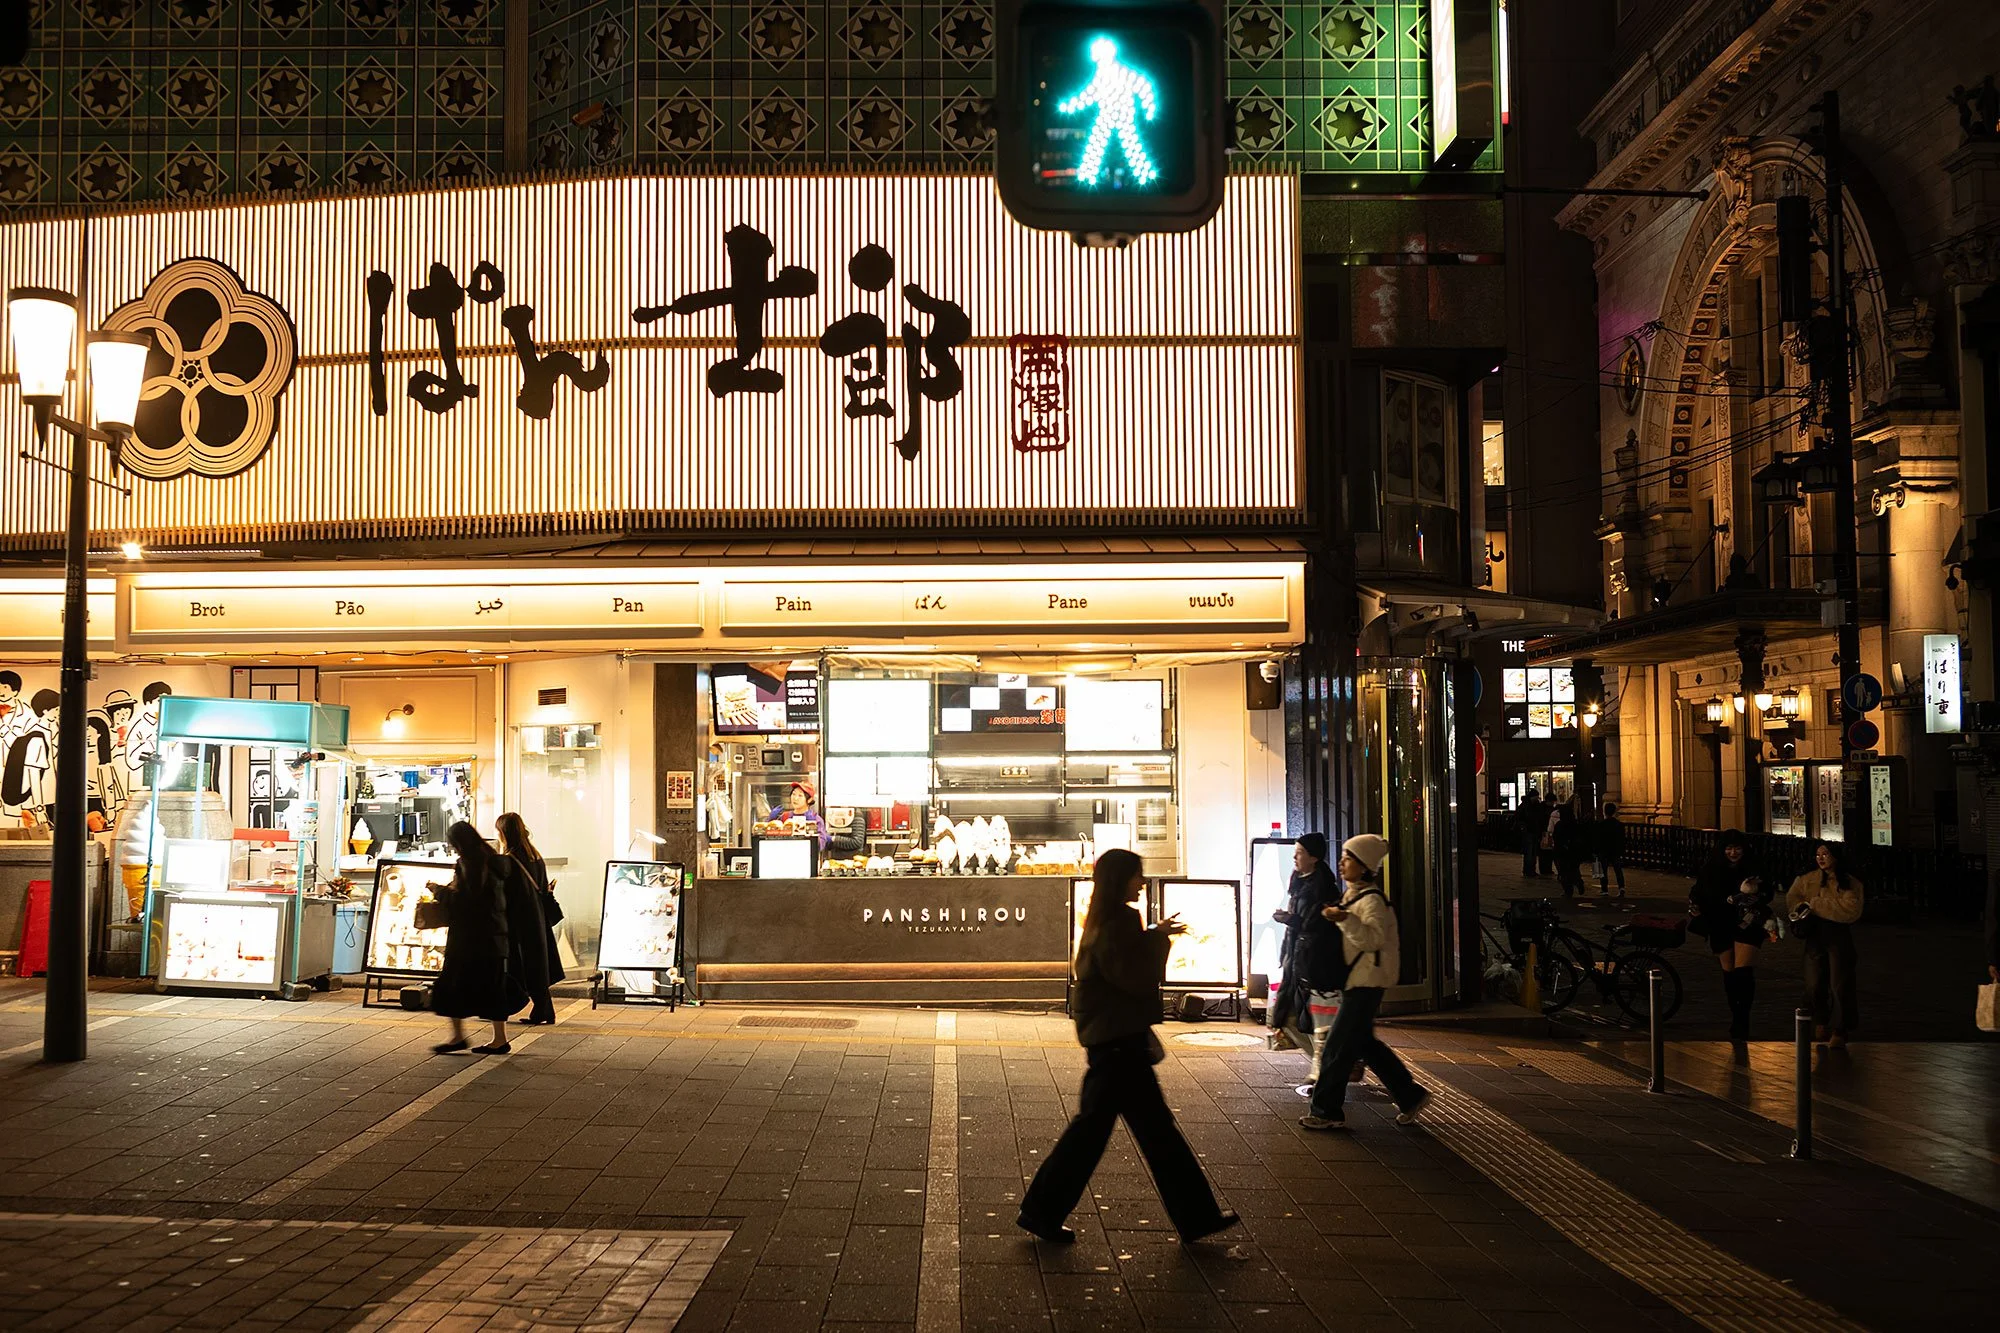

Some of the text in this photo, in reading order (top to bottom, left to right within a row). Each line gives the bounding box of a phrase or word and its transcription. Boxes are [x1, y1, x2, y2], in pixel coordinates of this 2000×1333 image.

[335, 600, 365, 616] Pão
[475, 598, 503, 615] خبز
[612, 597, 645, 613] Pan
[775, 596, 812, 612] Pain
[1048, 594, 1087, 609] Pane
[1189, 592, 1234, 608] ขนมปัง
[190, 602, 225, 617] Brot
[1501, 640, 1526, 653] THE
[1934, 659, 1950, 715] はり重
[863, 907, 1026, 923] PANSHIROU
